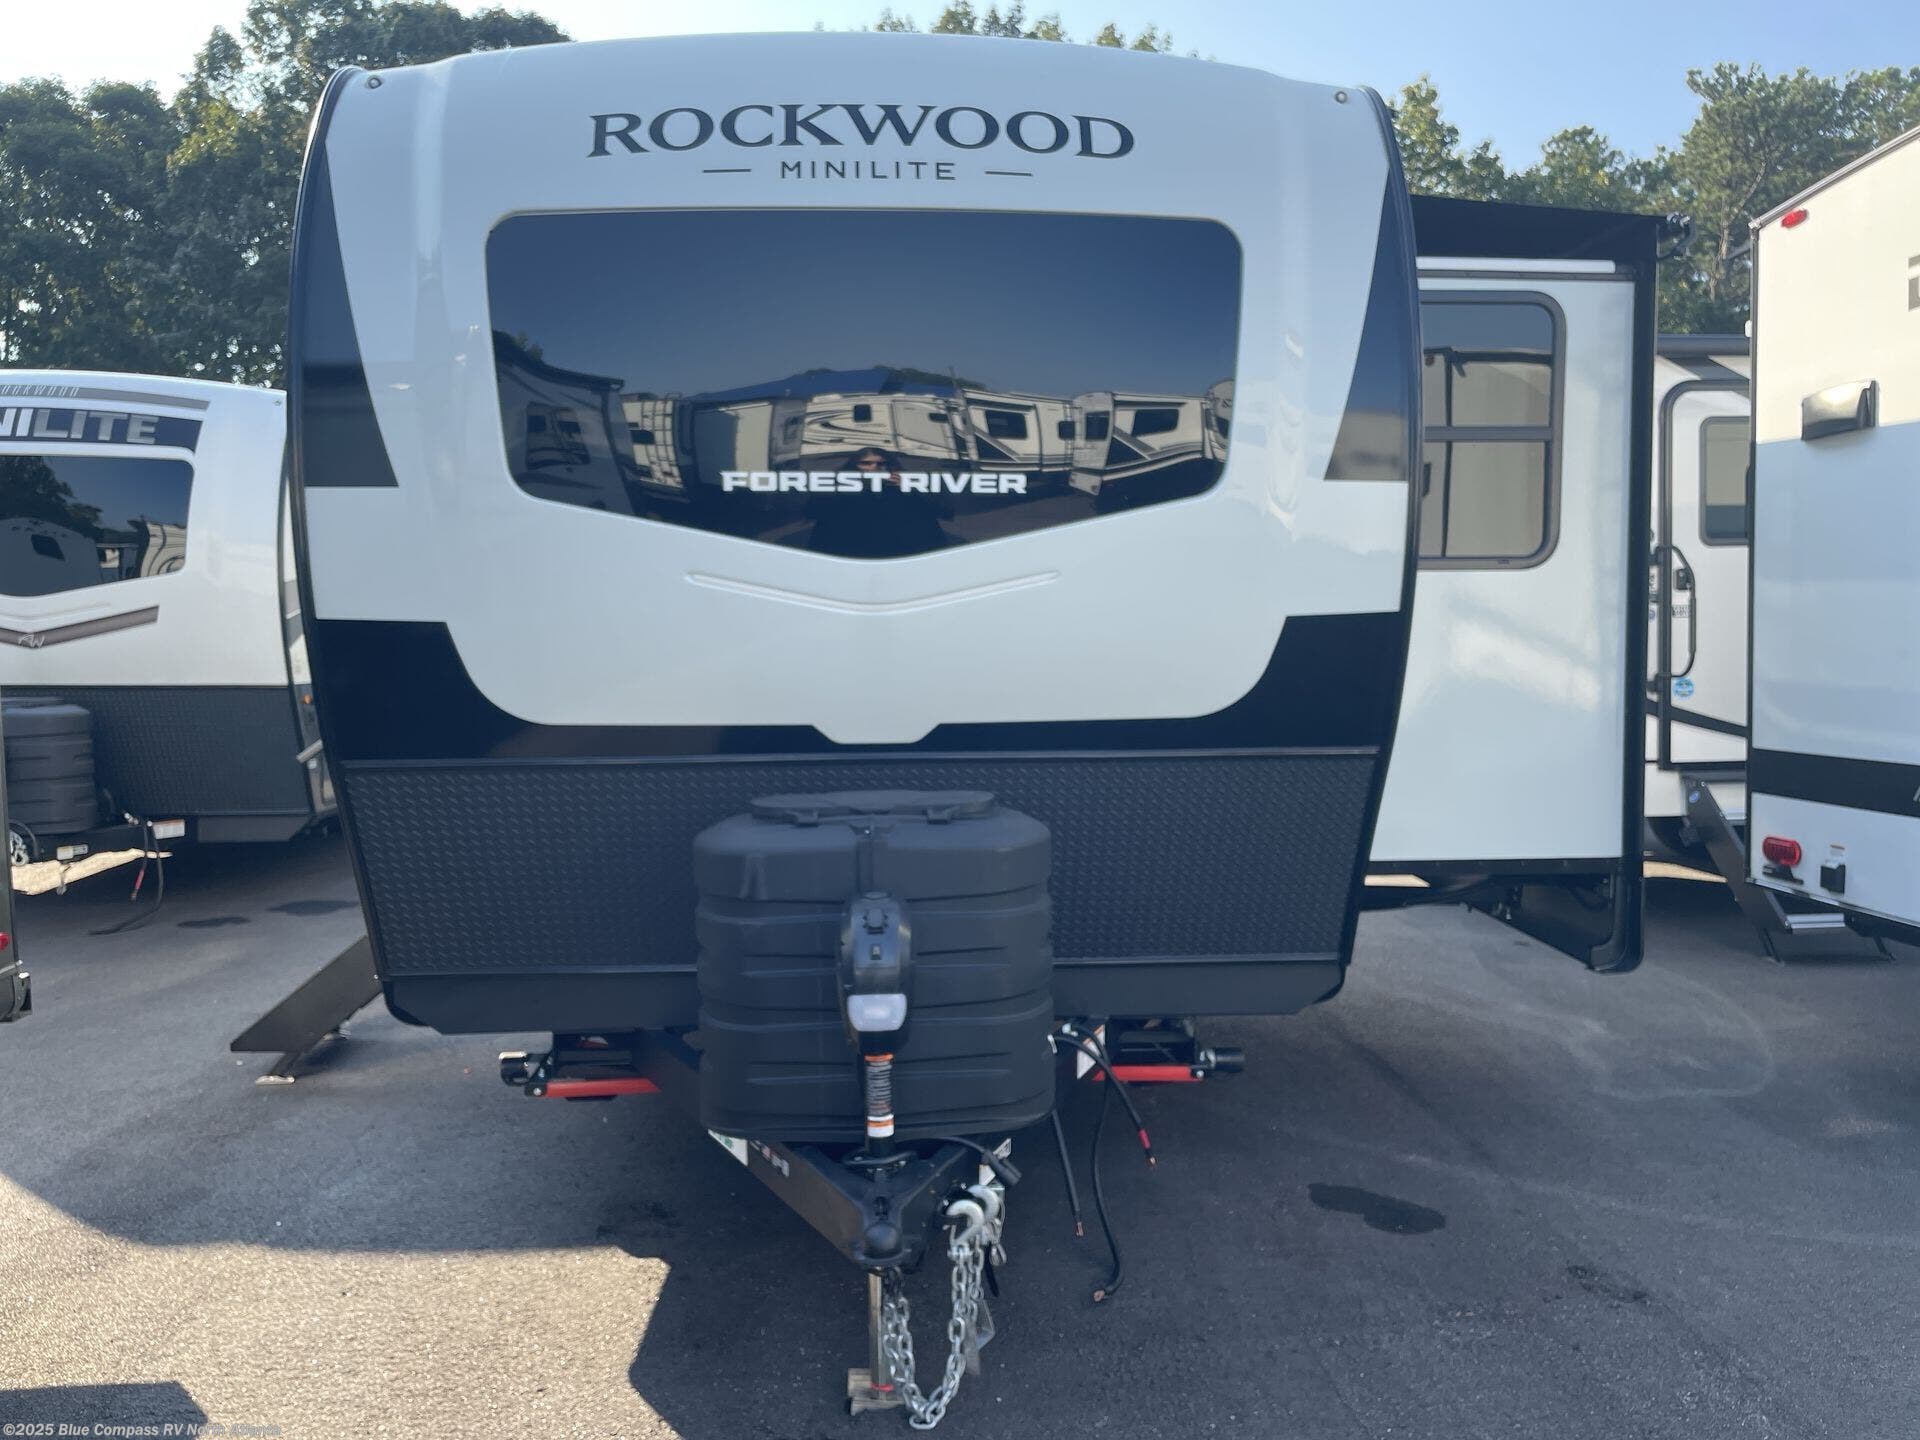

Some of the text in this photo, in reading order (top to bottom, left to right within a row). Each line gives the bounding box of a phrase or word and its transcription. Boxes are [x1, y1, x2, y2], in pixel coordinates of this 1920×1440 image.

[586, 103, 1135, 159] ROCKWOOD
[780, 160, 956, 181] MINILITE
[719, 470, 1028, 495] FOREST RIVER
